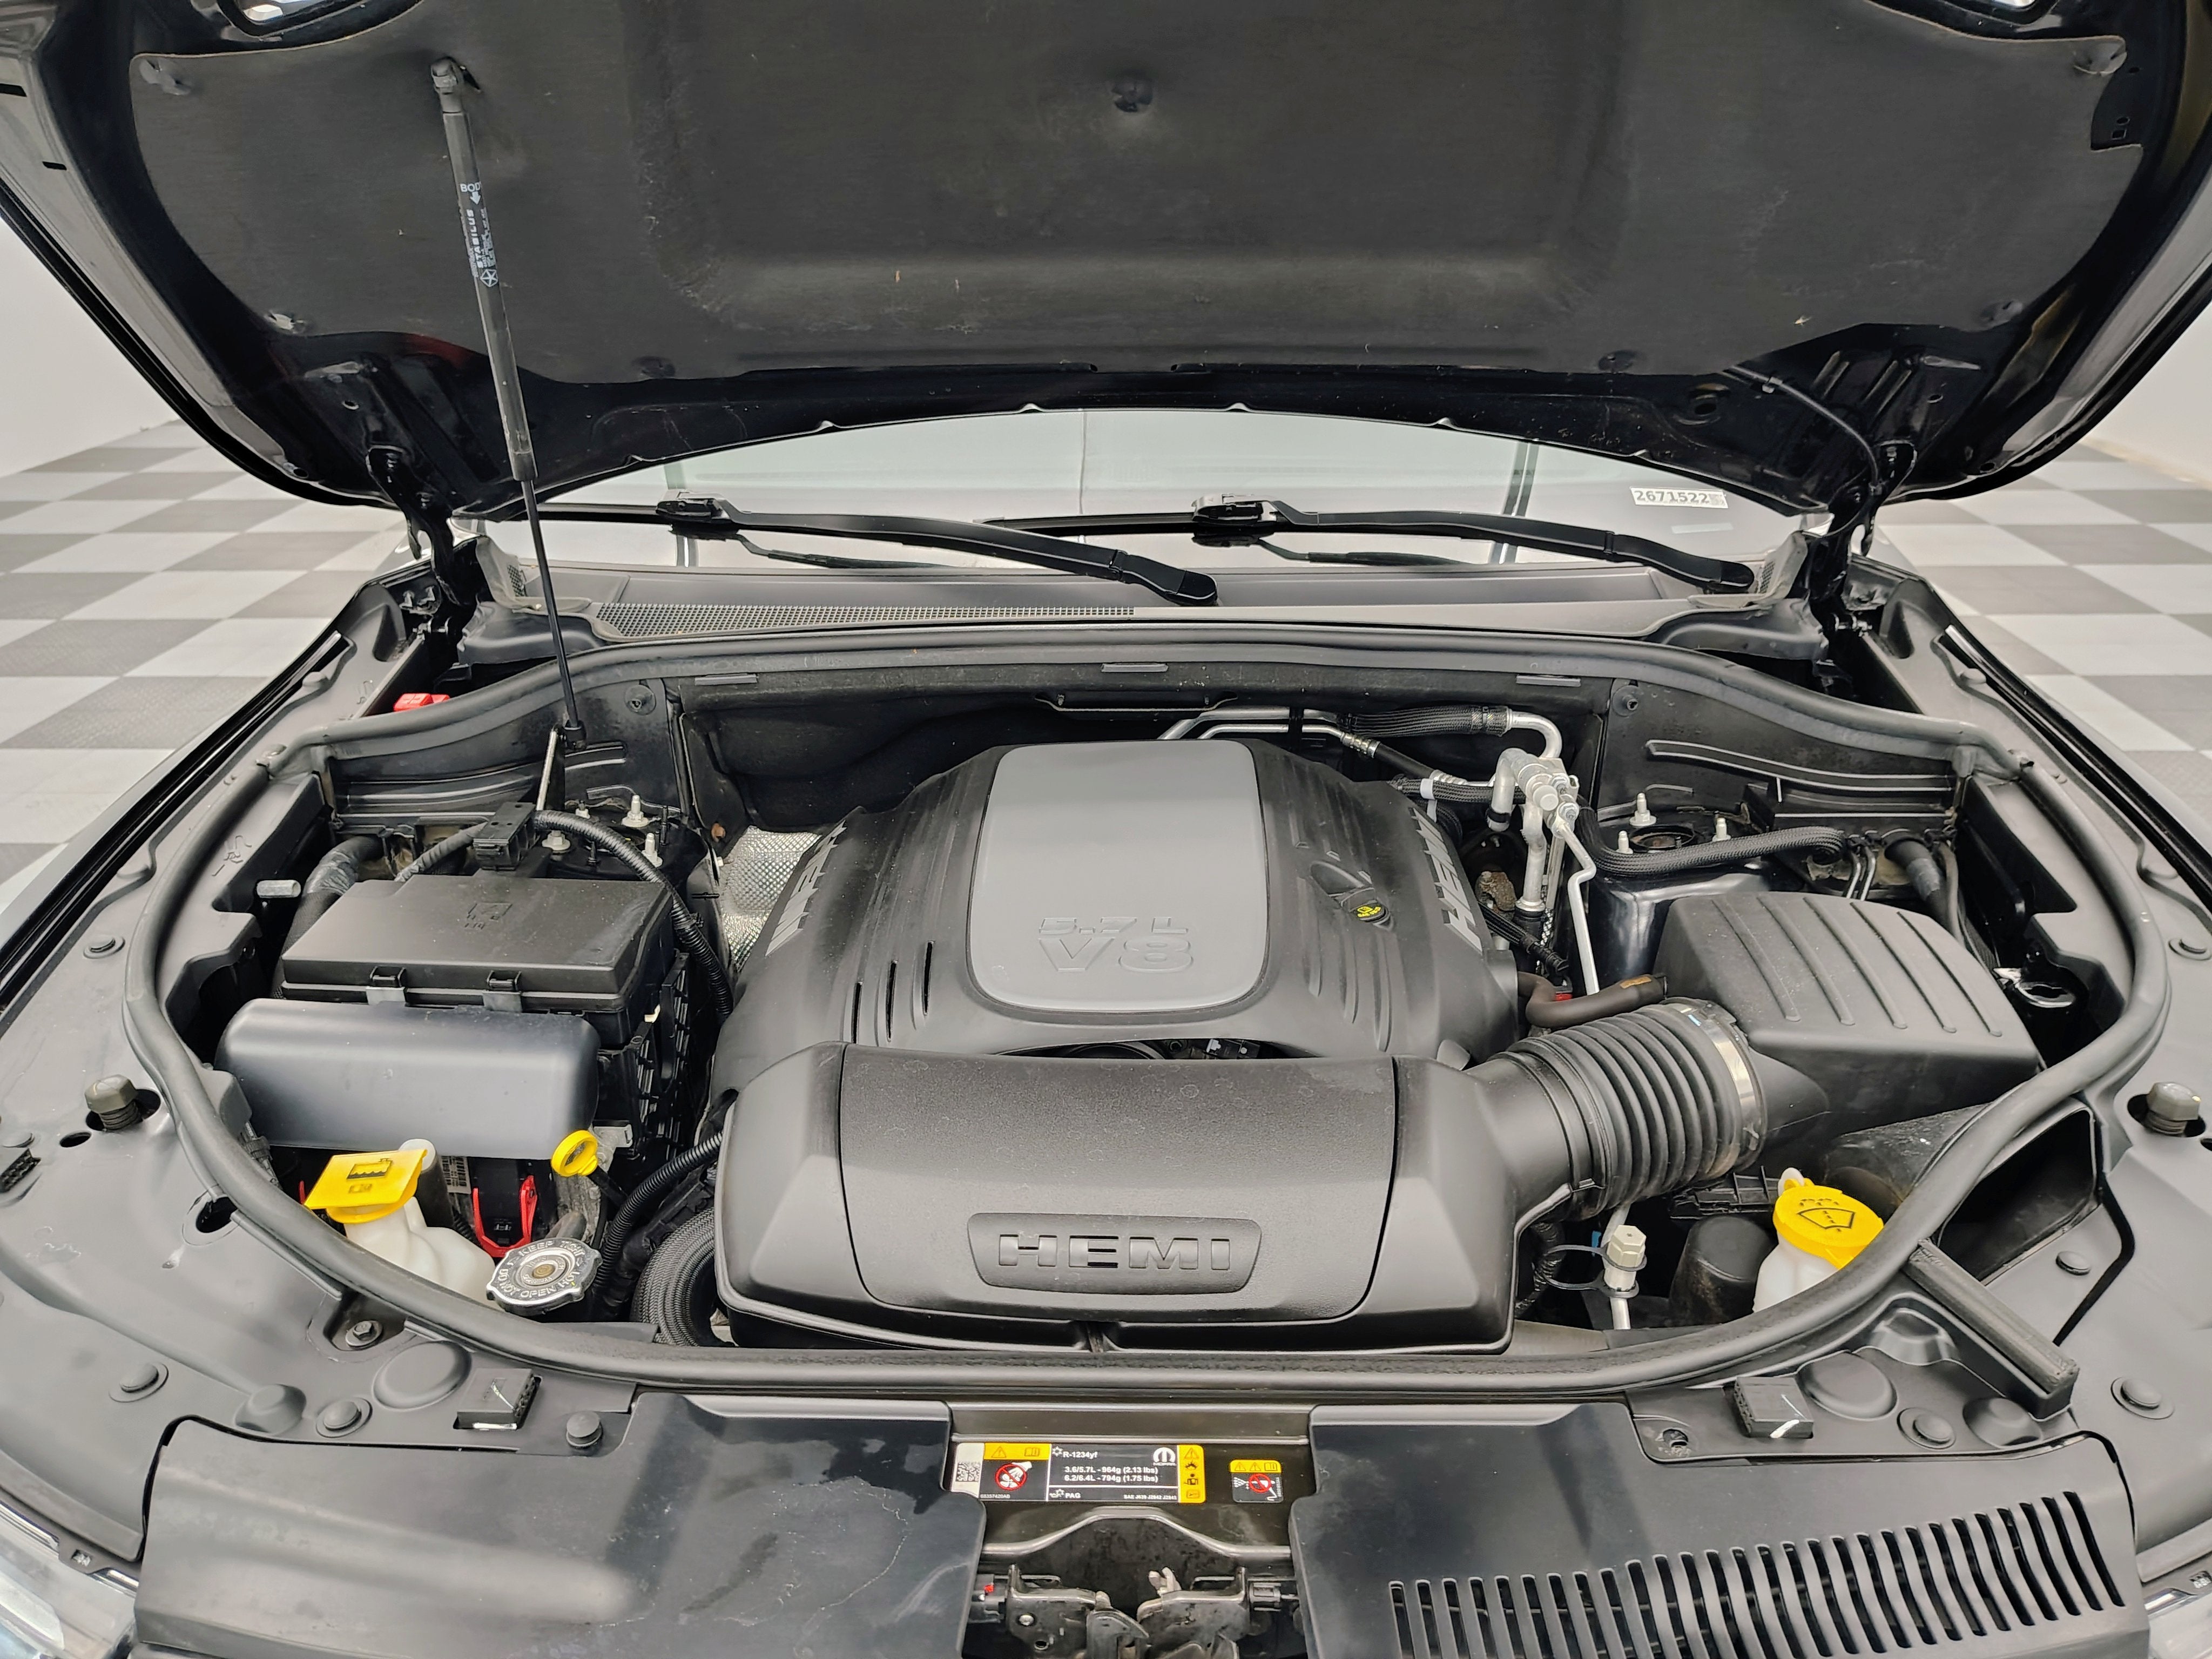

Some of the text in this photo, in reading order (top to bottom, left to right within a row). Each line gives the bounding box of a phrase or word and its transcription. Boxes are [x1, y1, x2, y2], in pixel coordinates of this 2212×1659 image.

[460, 181, 482, 192] BOD
[467, 209, 484, 268] STABILUS
[1634, 490, 1710, 504] 2671522
[1408, 807, 1483, 955] HEMI
[1037, 936, 1194, 973] V8
[518, 1240, 554, 1257] KEEP
[998, 1233, 1231, 1271] HEMI
[498, 1269, 510, 1282] DO
[558, 1271, 581, 1288] HOT
[499, 1281, 522, 1296] NOT
[521, 1285, 558, 1298] OPEN
[1063, 1451, 1098, 1459] R-1234yf
[1123, 1466, 1142, 1474] (2.13
[1143, 1466, 1158, 1474] lbs)
[1102, 1475, 1121, 1483] 794g
[1123, 1475, 1142, 1483] (1.75
[1143, 1475, 1158, 1483] lbs)
